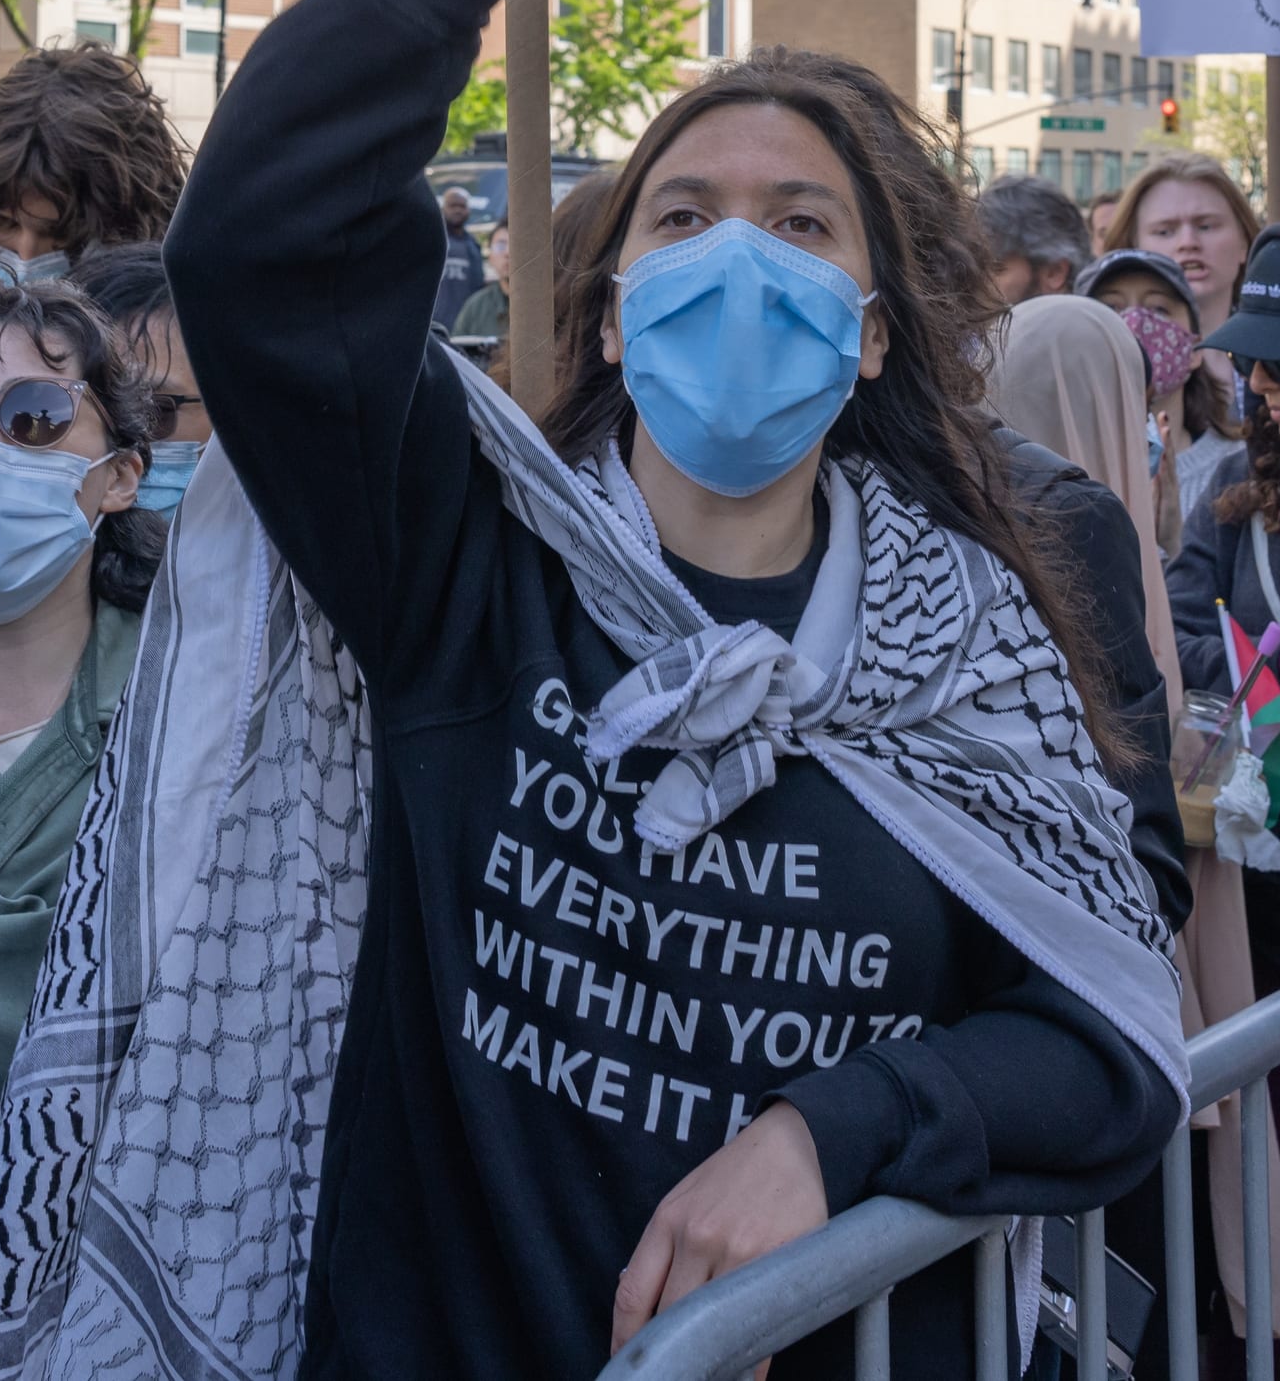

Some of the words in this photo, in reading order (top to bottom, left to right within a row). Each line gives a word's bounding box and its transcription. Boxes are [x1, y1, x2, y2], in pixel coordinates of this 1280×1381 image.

[509, 746, 624, 855] YOU
[639, 832, 821, 900] HAVE
[483, 830, 892, 989] EVERYTHING
[461, 988, 631, 1123] MAKE
[643, 1073, 712, 1143] IT
[474, 909, 701, 1054] WITHIN
[721, 1002, 857, 1069] YOU
